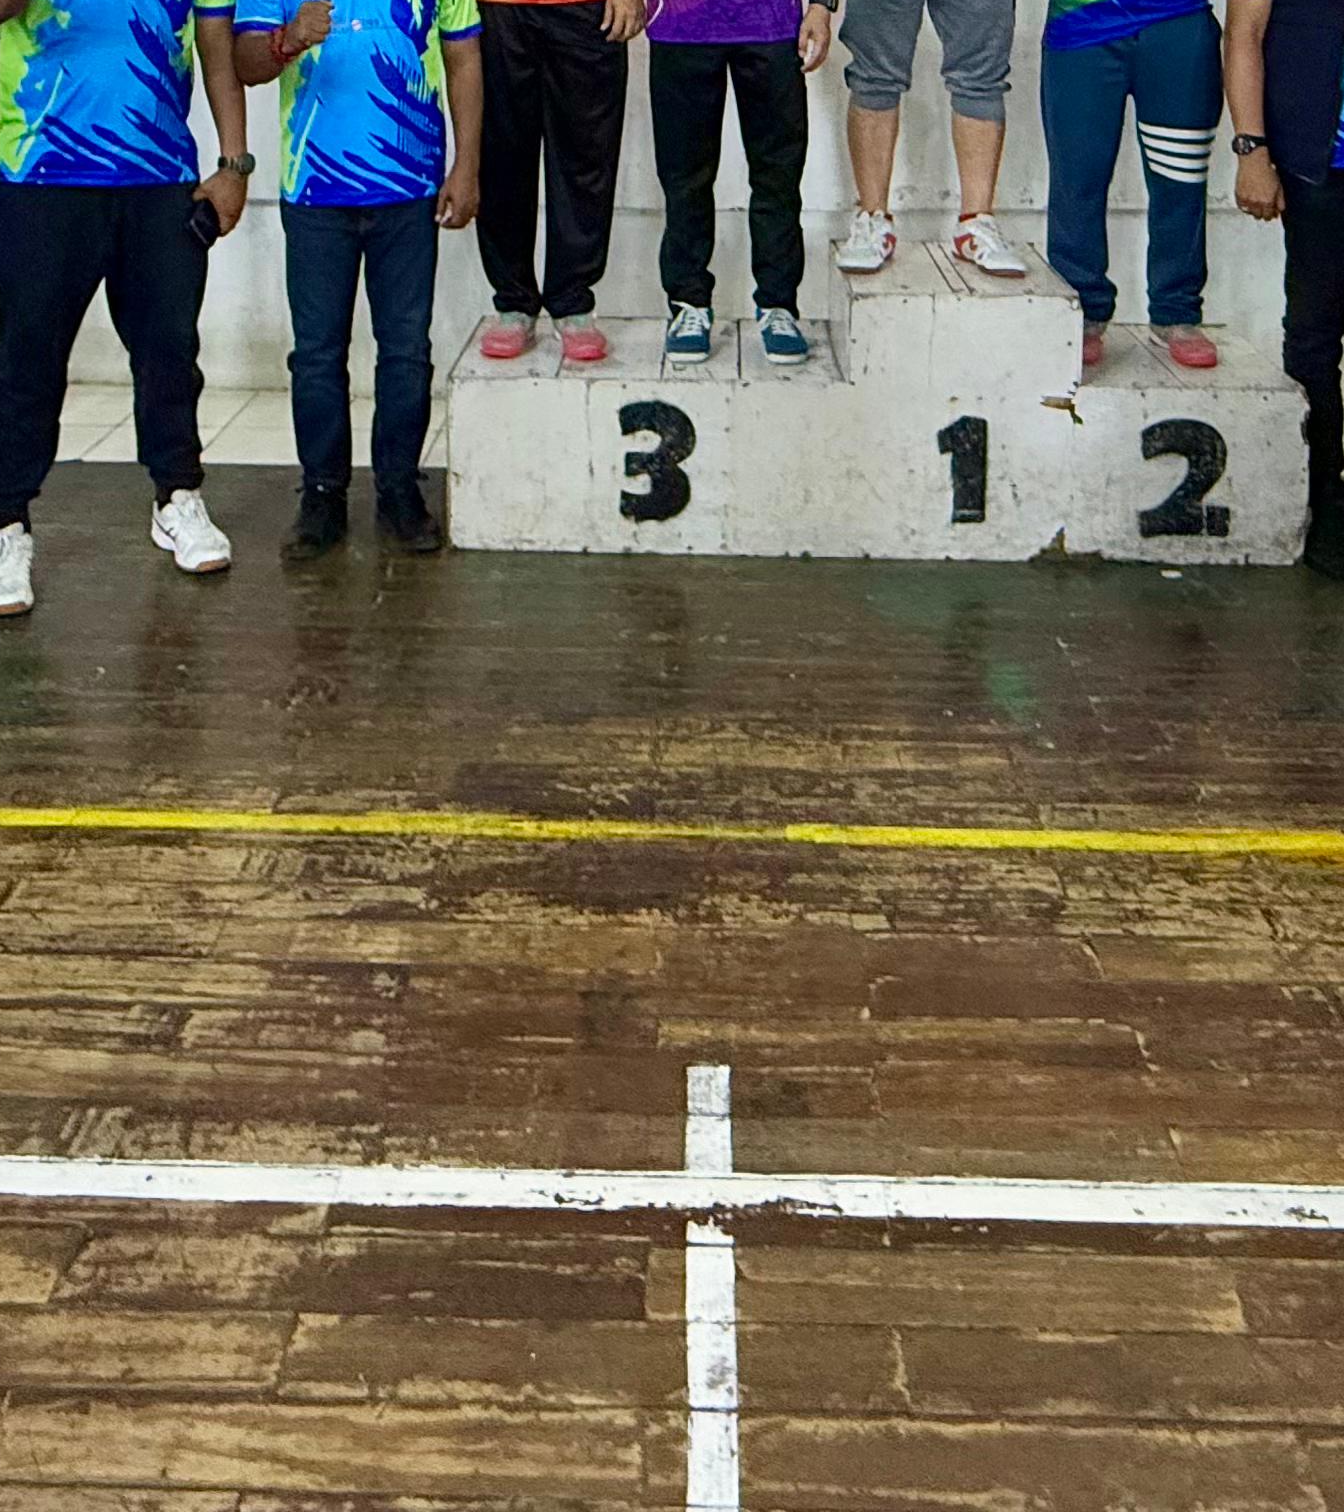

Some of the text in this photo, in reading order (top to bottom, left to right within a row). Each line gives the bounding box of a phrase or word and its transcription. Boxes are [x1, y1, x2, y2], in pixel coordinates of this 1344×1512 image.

[618, 401, 697, 523] 3
[936, 415, 988, 523] 1
[1140, 418, 1231, 538] 2
